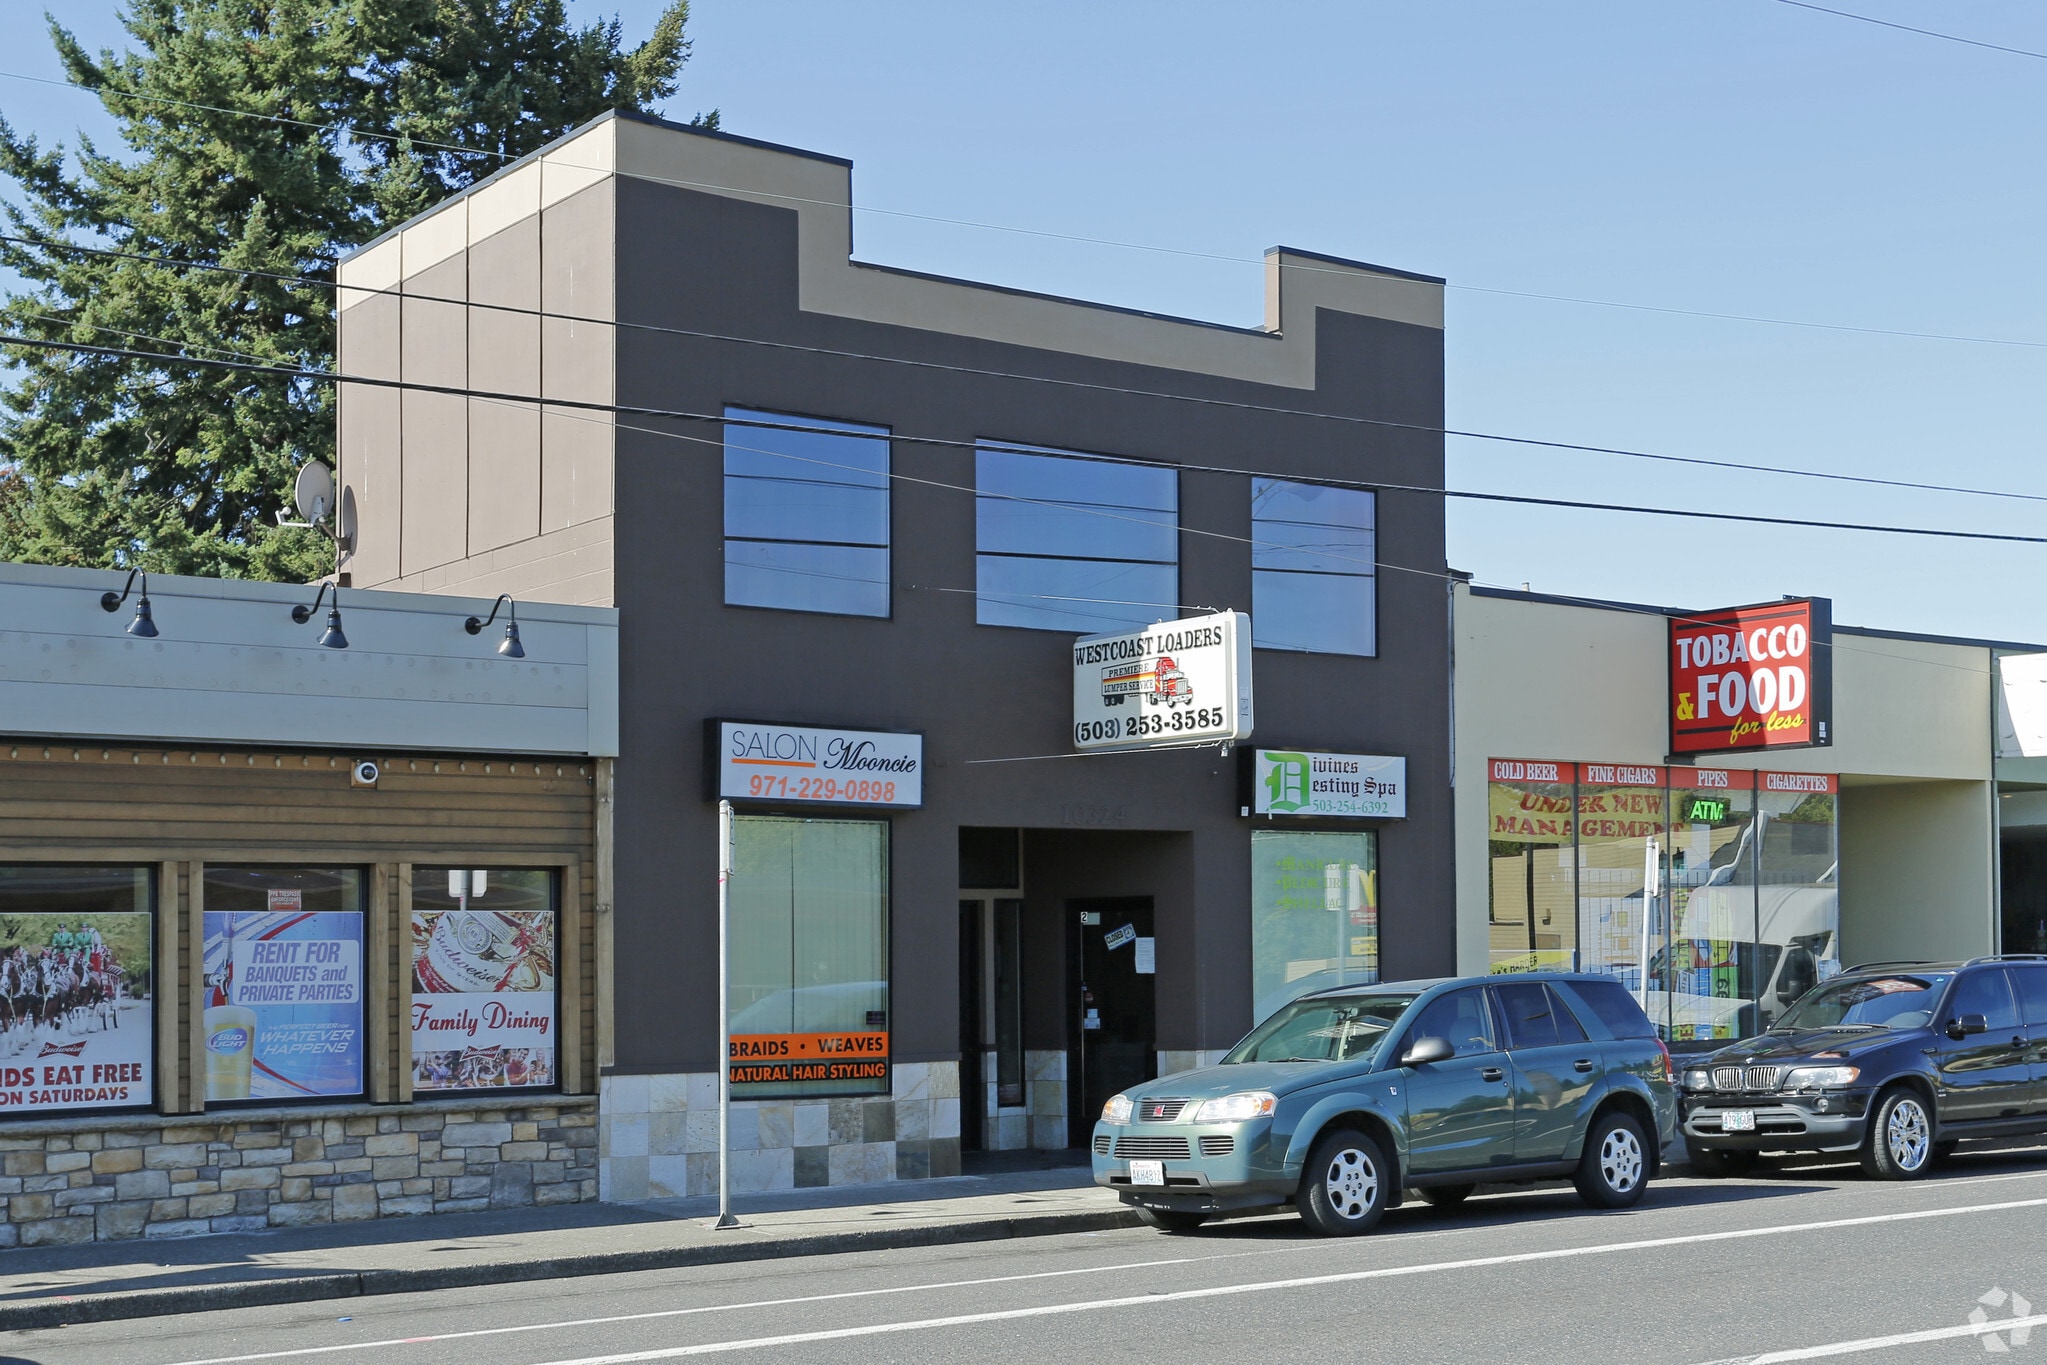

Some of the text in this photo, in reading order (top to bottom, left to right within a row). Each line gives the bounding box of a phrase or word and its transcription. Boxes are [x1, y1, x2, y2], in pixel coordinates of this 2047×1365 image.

[1075, 625, 1222, 666] WESTCOAST LOADERS
[1676, 623, 1806, 669] TOBACCO
[1108, 662, 1150, 678] PREMIERE
[1104, 679, 1154, 694] LUMPER SERVICE
[1676, 665, 1806, 721] & FOOD
[1075, 706, 1224, 743] (503) 253-3585
[1729, 716, 1762, 744] for
[1766, 710, 1804, 732] less
[732, 730, 917, 773] SALON Mooncie
[1494, 762, 1559, 782] COLD BEER
[1587, 765, 1657, 785] FINE CIGARS
[1697, 770, 1728, 787] PIPES
[749, 774, 896, 802] 971-229-0898
[1363, 776, 1397, 798] Spa
[1767, 773, 1828, 792] CIGARETTES
[1313, 799, 1389, 814] 503-254-6392
[1519, 792, 1663, 815] UNDER NEW
[1690, 800, 1724, 821] ATM
[1494, 814, 1684, 839] MANAGEMENT
[1082, 912, 1088, 922] 2
[1105, 930, 1124, 945] CLOSED
[252, 942, 341, 964] RENT FOR
[434, 925, 503, 984] Budweiser
[245, 965, 348, 984] BANQUETS and
[238, 983, 354, 1002] PRIVATE PARTIES
[412, 1001, 550, 1037] Family Dining
[260, 1029, 356, 1043] WHATEVER
[263, 1042, 349, 1055] HAPPENS
[729, 1037, 884, 1057] BRAIDS WEAVES
[44, 1065, 85, 1086] EAT
[93, 1063, 143, 1084] FREE
[793, 1065, 827, 1080] HAIR
[830, 1063, 886, 1078] STYLING
[29, 1087, 129, 1104] SATURDAYS
